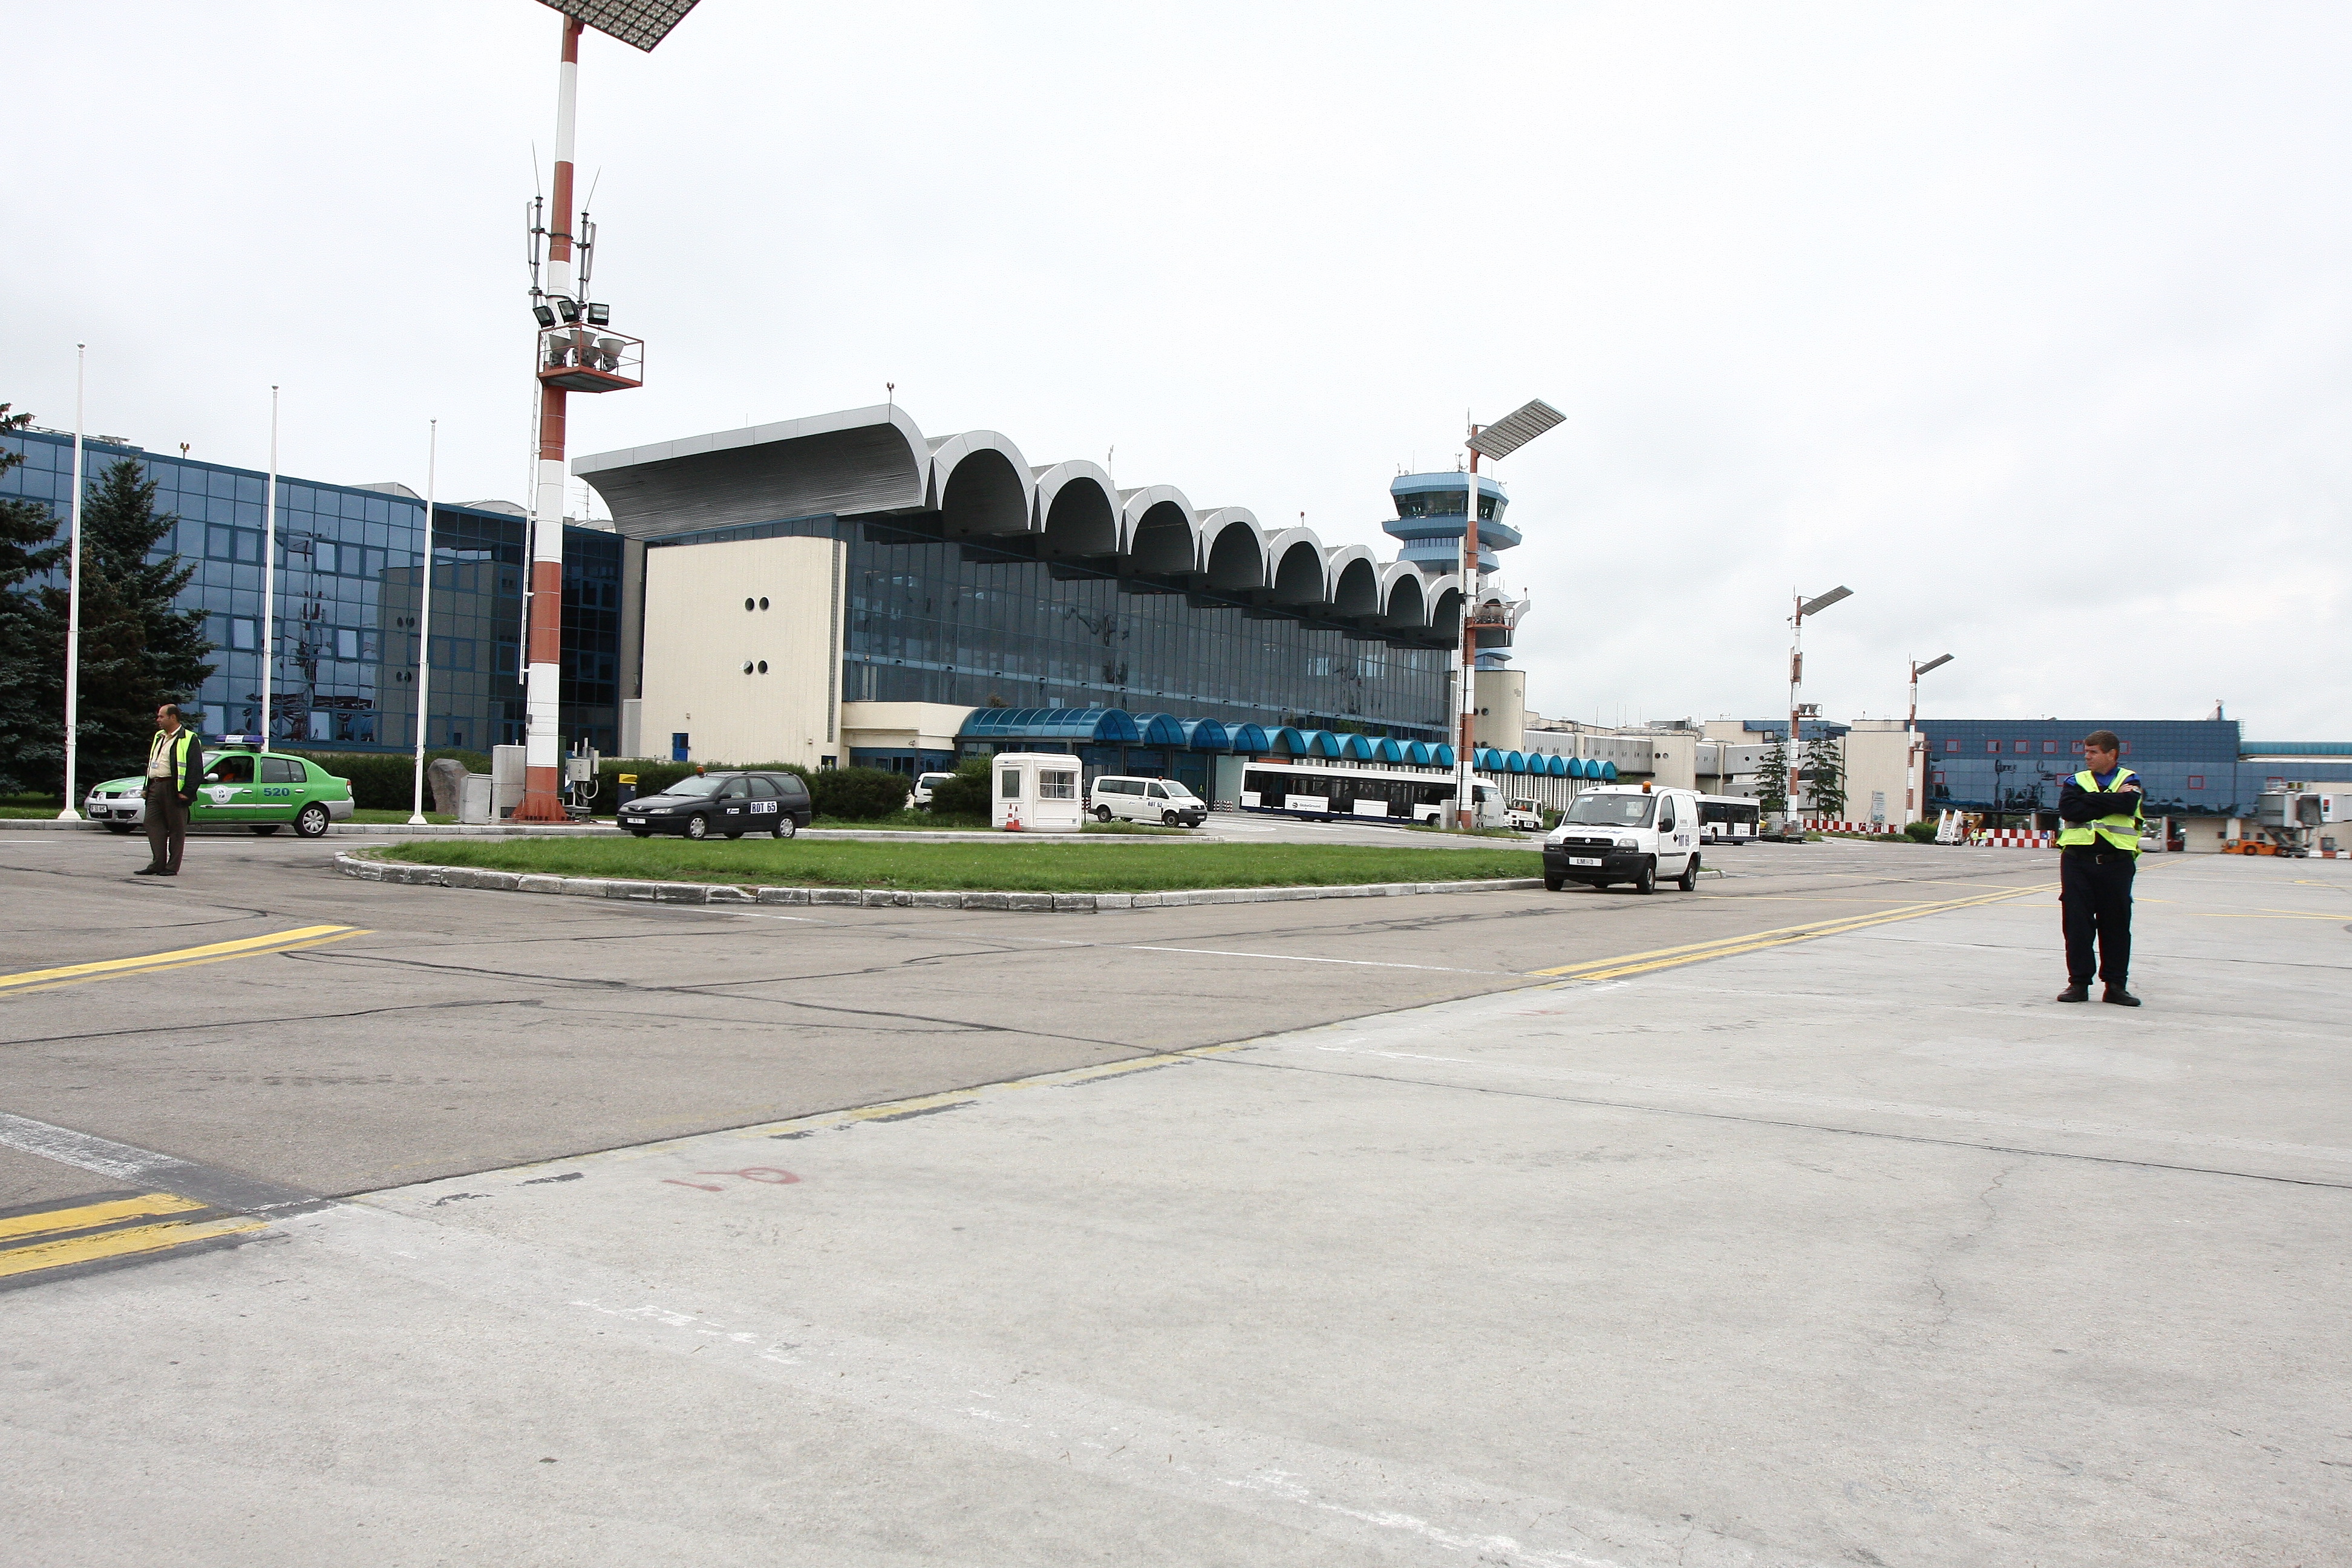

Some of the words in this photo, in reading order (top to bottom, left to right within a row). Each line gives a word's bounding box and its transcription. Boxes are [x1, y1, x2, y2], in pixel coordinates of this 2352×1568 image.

[263, 788, 290, 797] 520
[752, 802, 765, 813] ROT
[767, 802, 776, 812] 65
